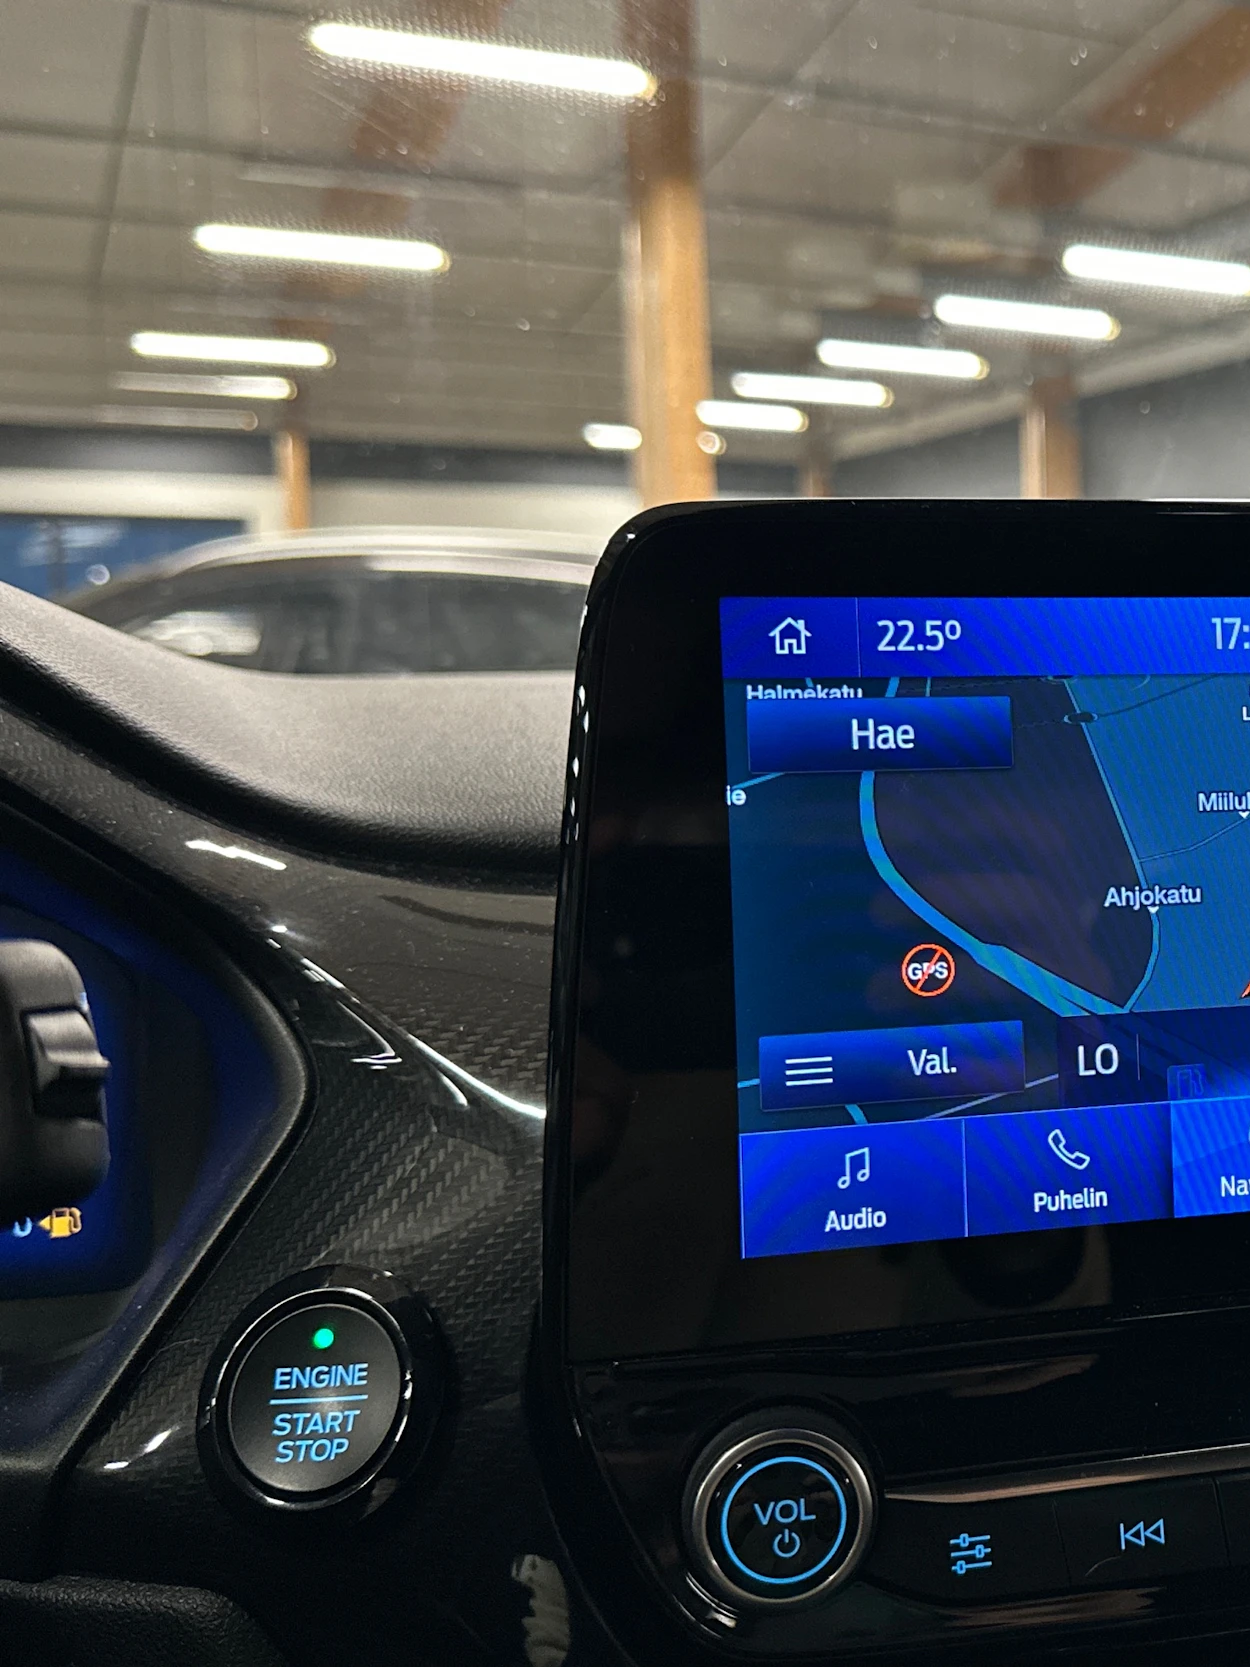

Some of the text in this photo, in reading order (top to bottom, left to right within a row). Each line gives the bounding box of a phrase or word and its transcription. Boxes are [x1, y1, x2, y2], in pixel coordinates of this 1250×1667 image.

[851, 719, 915, 751] Hae
[1104, 886, 1202, 908] Ahjokatu
[907, 961, 949, 980] GPS
[907, 1049, 957, 1077] Val.
[1076, 1044, 1118, 1077] LO
[1033, 1188, 1108, 1213] Puhelin
[824, 1208, 887, 1233] Audio
[273, 1362, 369, 1390] ENGINE
[272, 1410, 361, 1437] START
[275, 1437, 350, 1464] STOP
[753, 1498, 817, 1526] VOL
